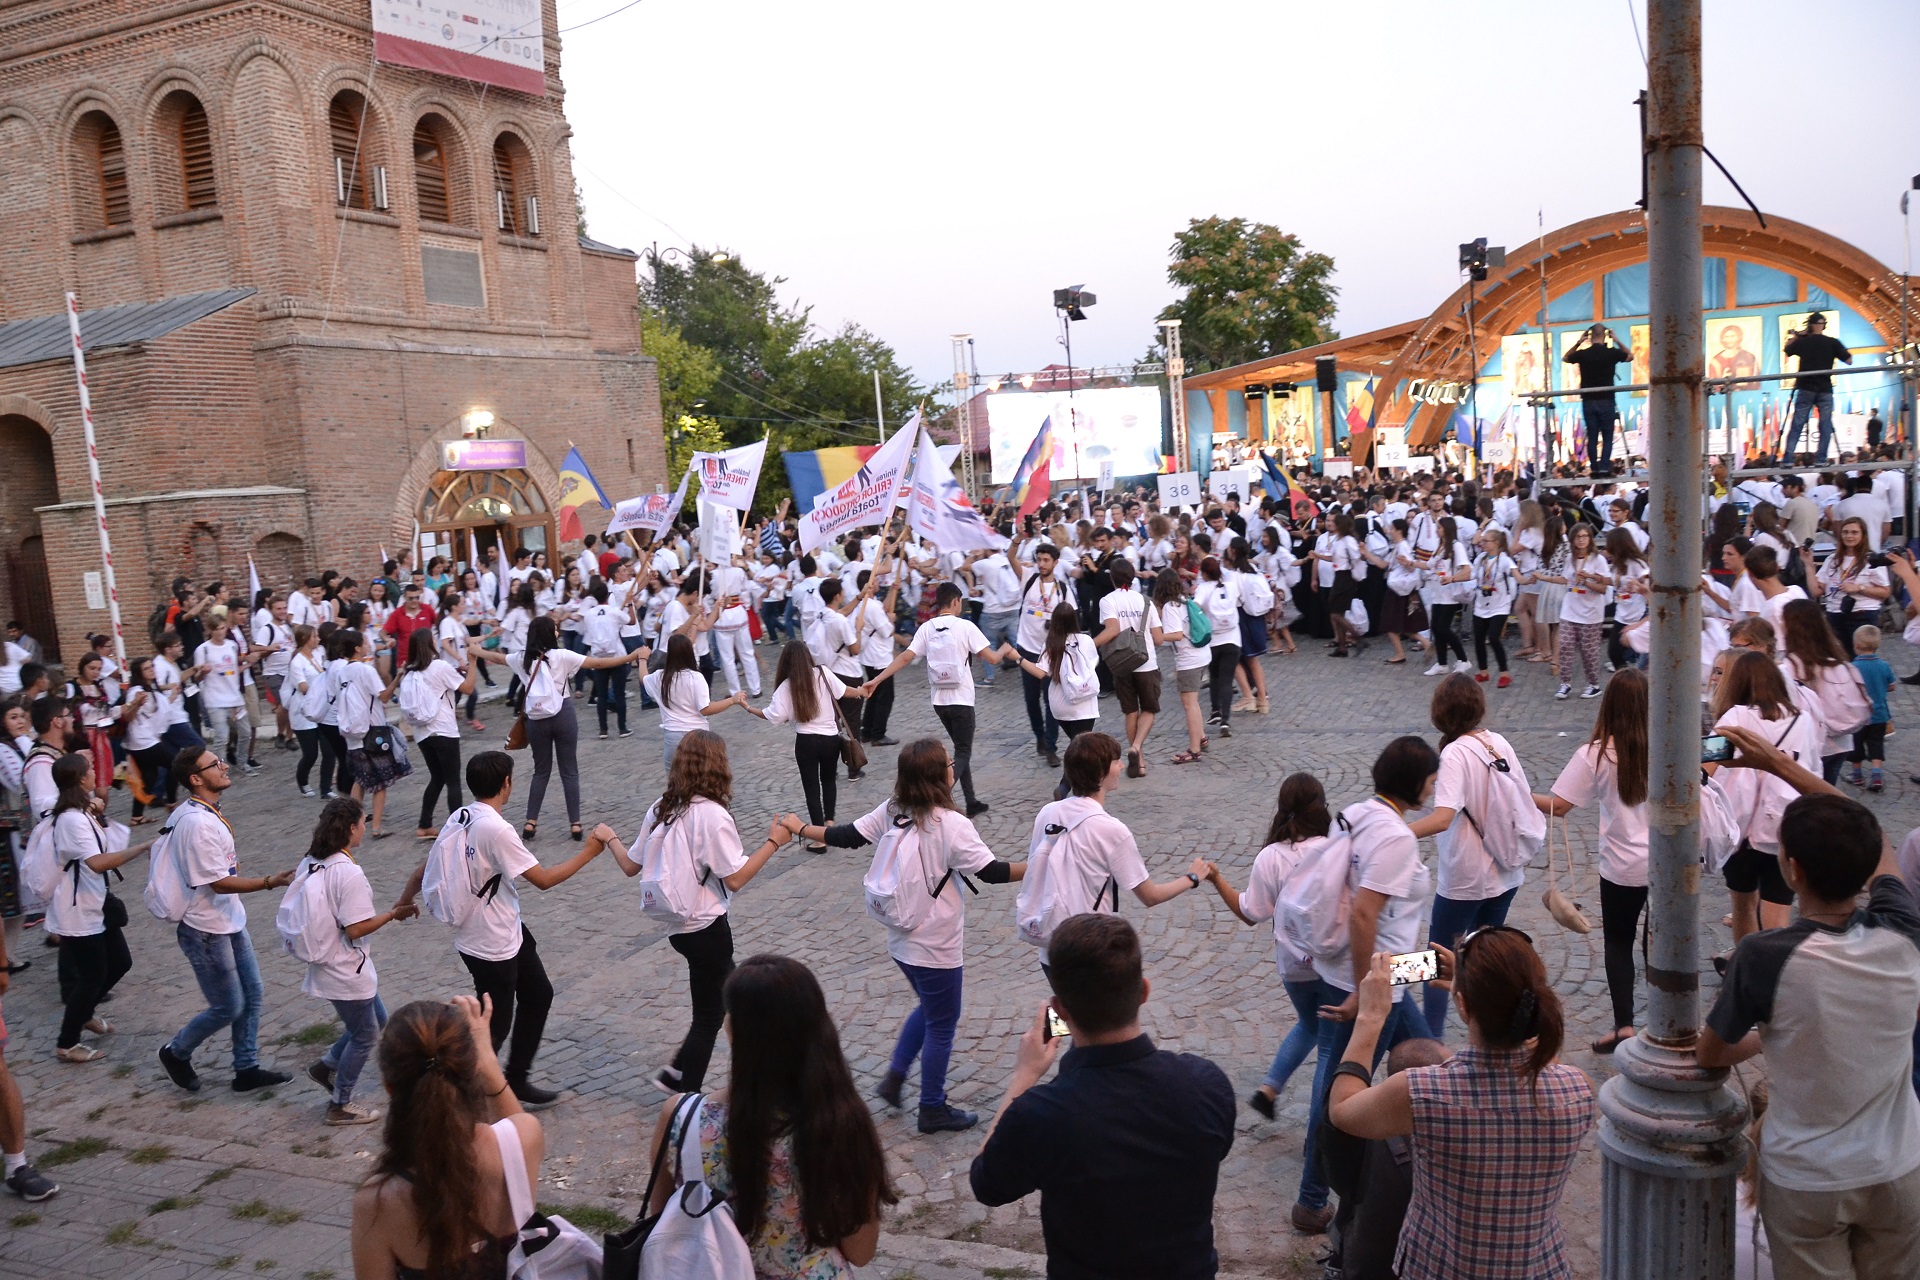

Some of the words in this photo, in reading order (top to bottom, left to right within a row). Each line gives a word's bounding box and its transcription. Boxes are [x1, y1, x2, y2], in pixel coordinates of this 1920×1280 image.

[1385, 451, 1400, 461] 12
[1488, 448, 1503, 457] 50
[1169, 484, 1190, 498] 38
[1218, 483, 1239, 496] 33
[1117, 610, 1142, 618] VOLUNTA
